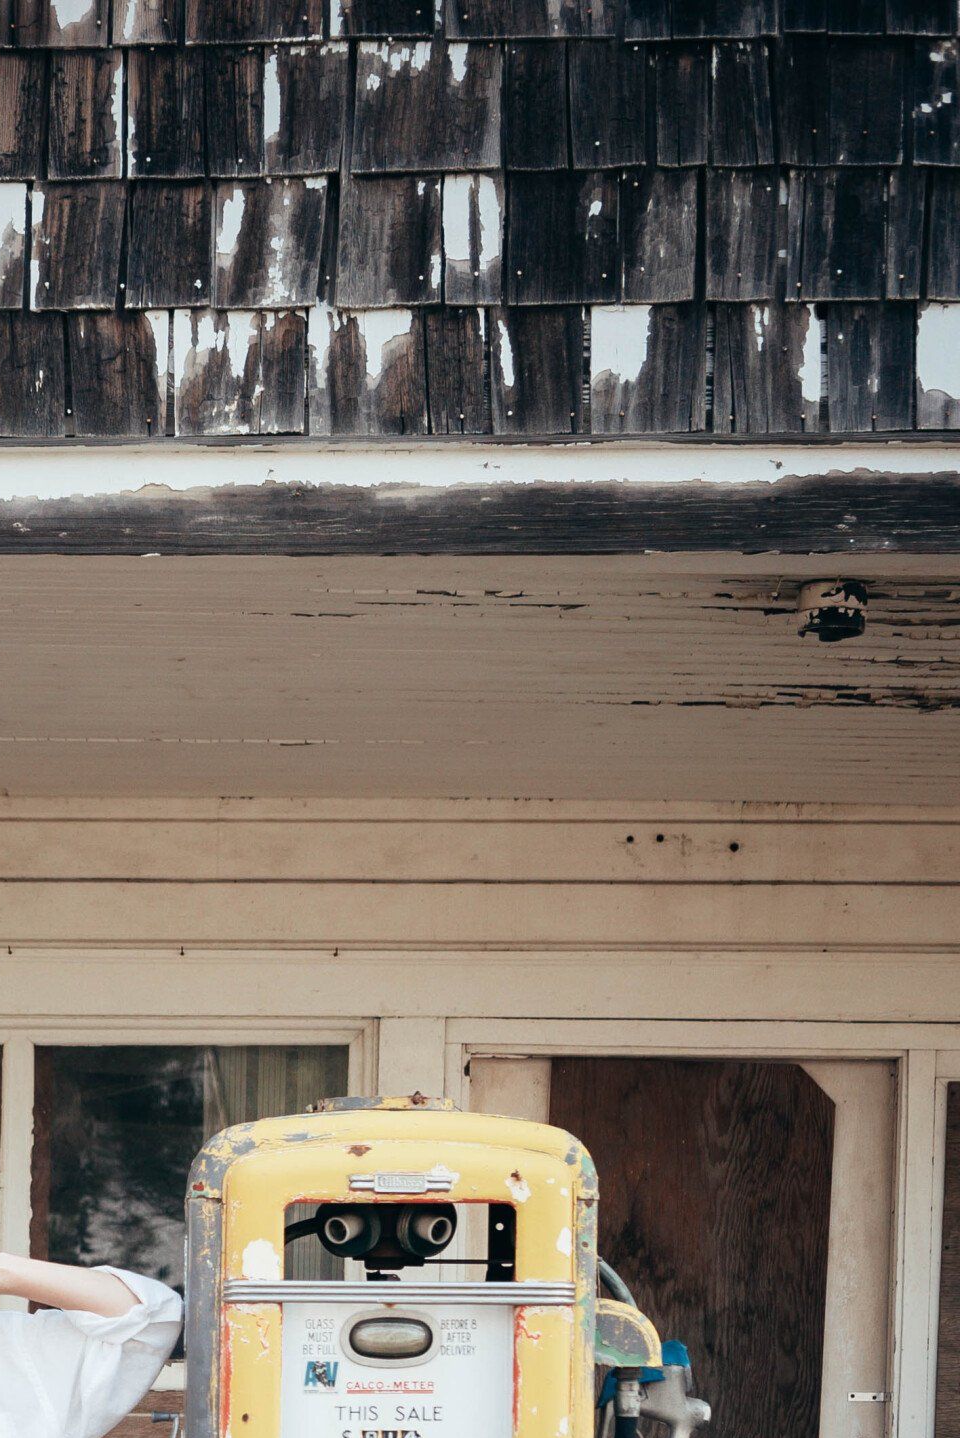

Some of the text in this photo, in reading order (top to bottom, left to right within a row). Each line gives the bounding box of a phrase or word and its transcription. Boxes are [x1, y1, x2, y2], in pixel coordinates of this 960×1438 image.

[304, 1318, 335, 1330] GLASS
[440, 1318, 469, 1330] BEFORE
[307, 1332, 333, 1342] MUST
[447, 1332, 471, 1343] AFTER
[302, 1344, 337, 1355] BE FULL
[440, 1345, 476, 1356] DELIVERY
[335, 1405, 443, 1421] THIS SALE
